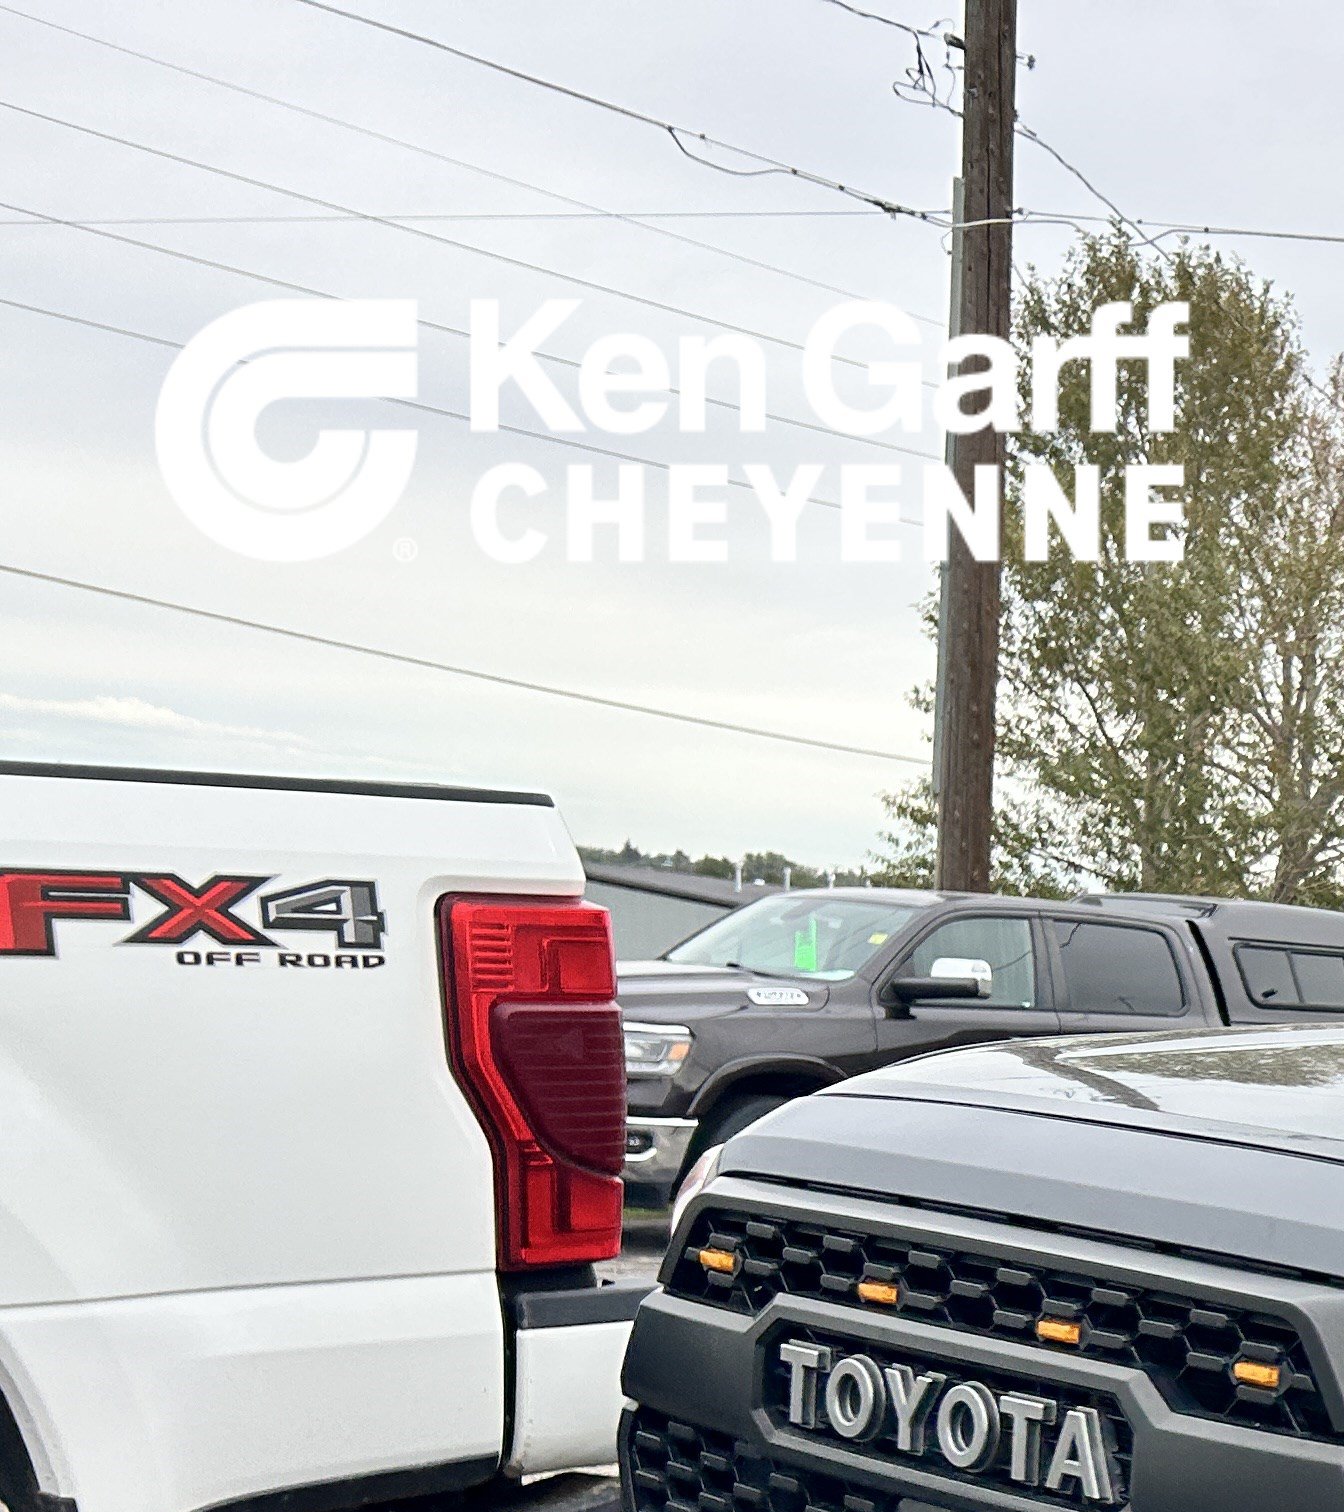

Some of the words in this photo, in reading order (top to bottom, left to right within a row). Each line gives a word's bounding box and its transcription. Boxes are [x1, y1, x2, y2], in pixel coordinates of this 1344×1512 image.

[0, 868, 387, 958] FX4
[176, 951, 260, 967] OFF
[277, 952, 386, 969] ROAD
[779, 1338, 1116, 1504] TOYOTA
